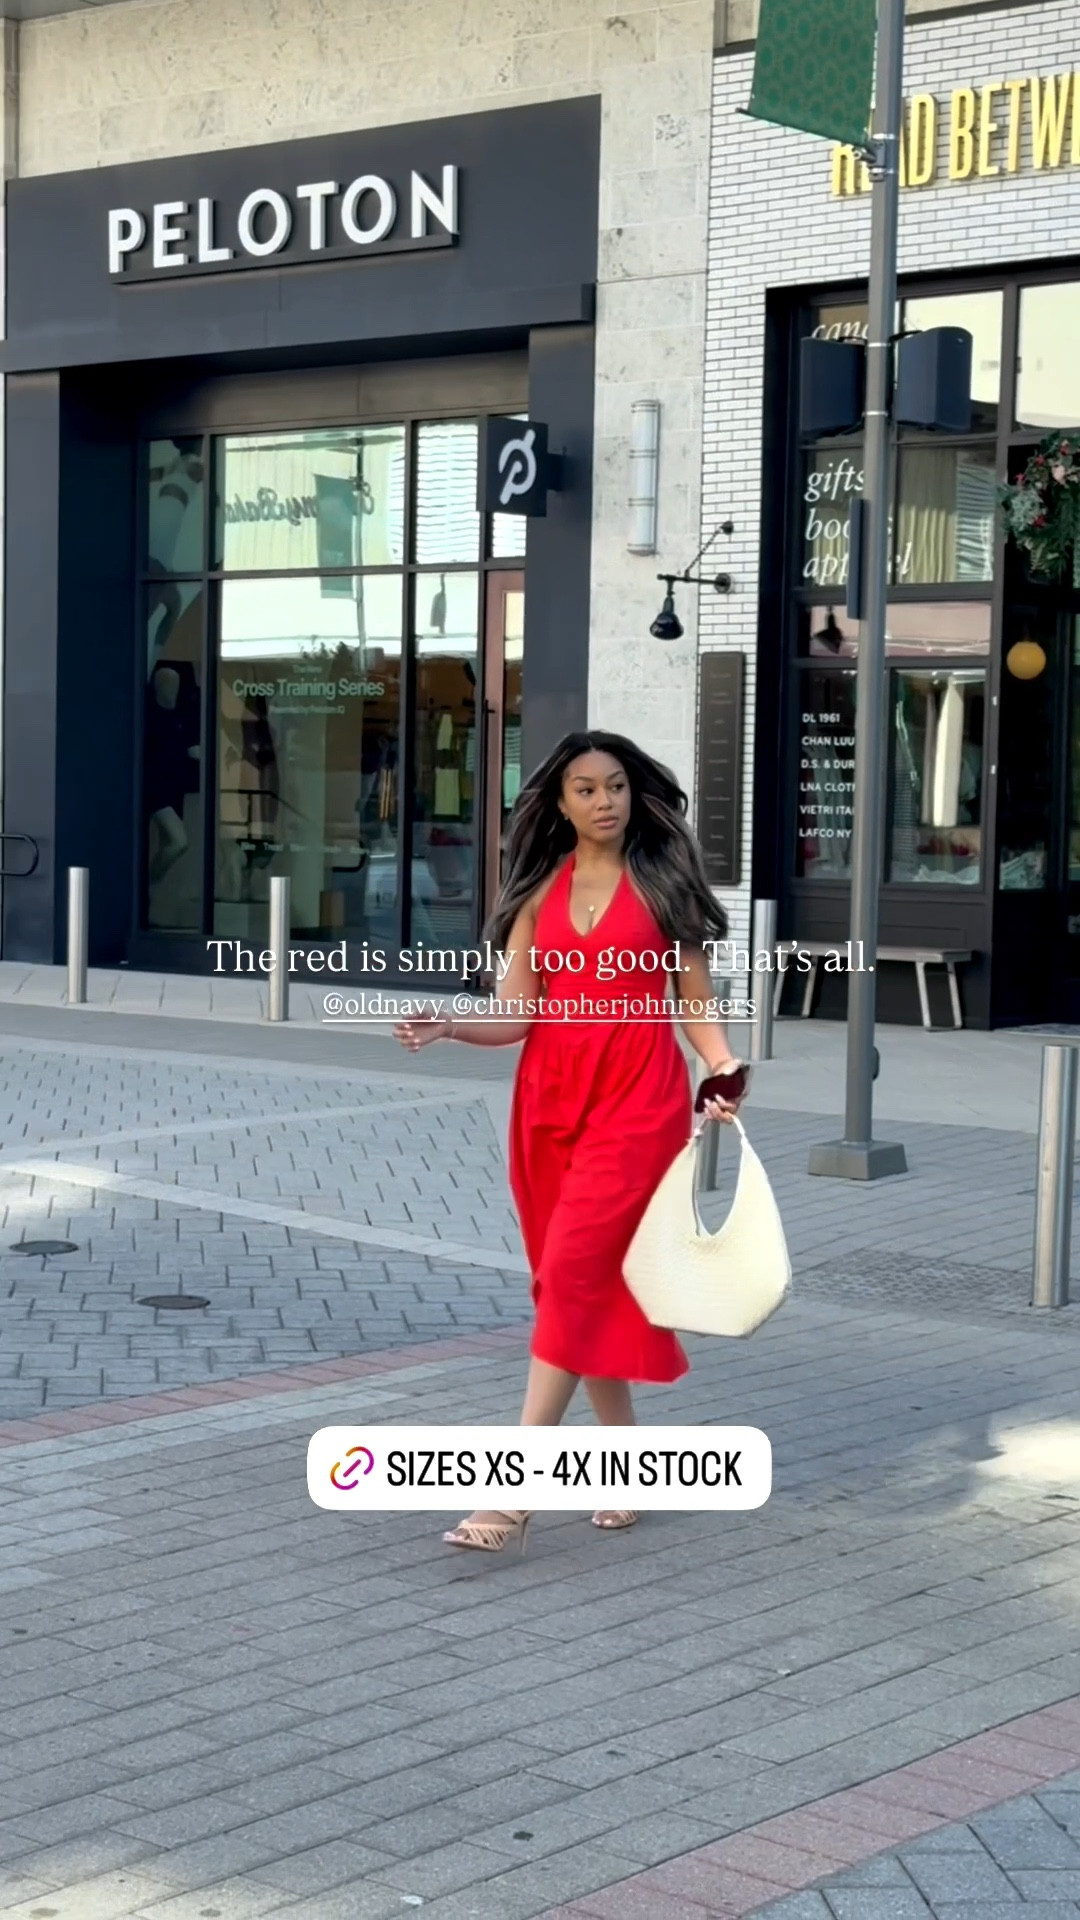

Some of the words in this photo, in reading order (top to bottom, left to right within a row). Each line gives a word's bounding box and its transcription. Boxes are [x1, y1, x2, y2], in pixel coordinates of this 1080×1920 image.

[108, 164, 460, 274] PELOTON
[232, 678, 275, 697] Cross
[276, 677, 336, 701] Training
[338, 677, 385, 697] Series
[802, 713, 817, 723] DL
[819, 713, 840, 723] 1961
[801, 736, 832, 746] CHAN
[823, 760, 831, 769] &
[800, 782, 821, 792] LNA
[799, 805, 834, 815] VIETRI
[798, 828, 834, 838] LAFCO
[836, 829, 852, 838] NY
